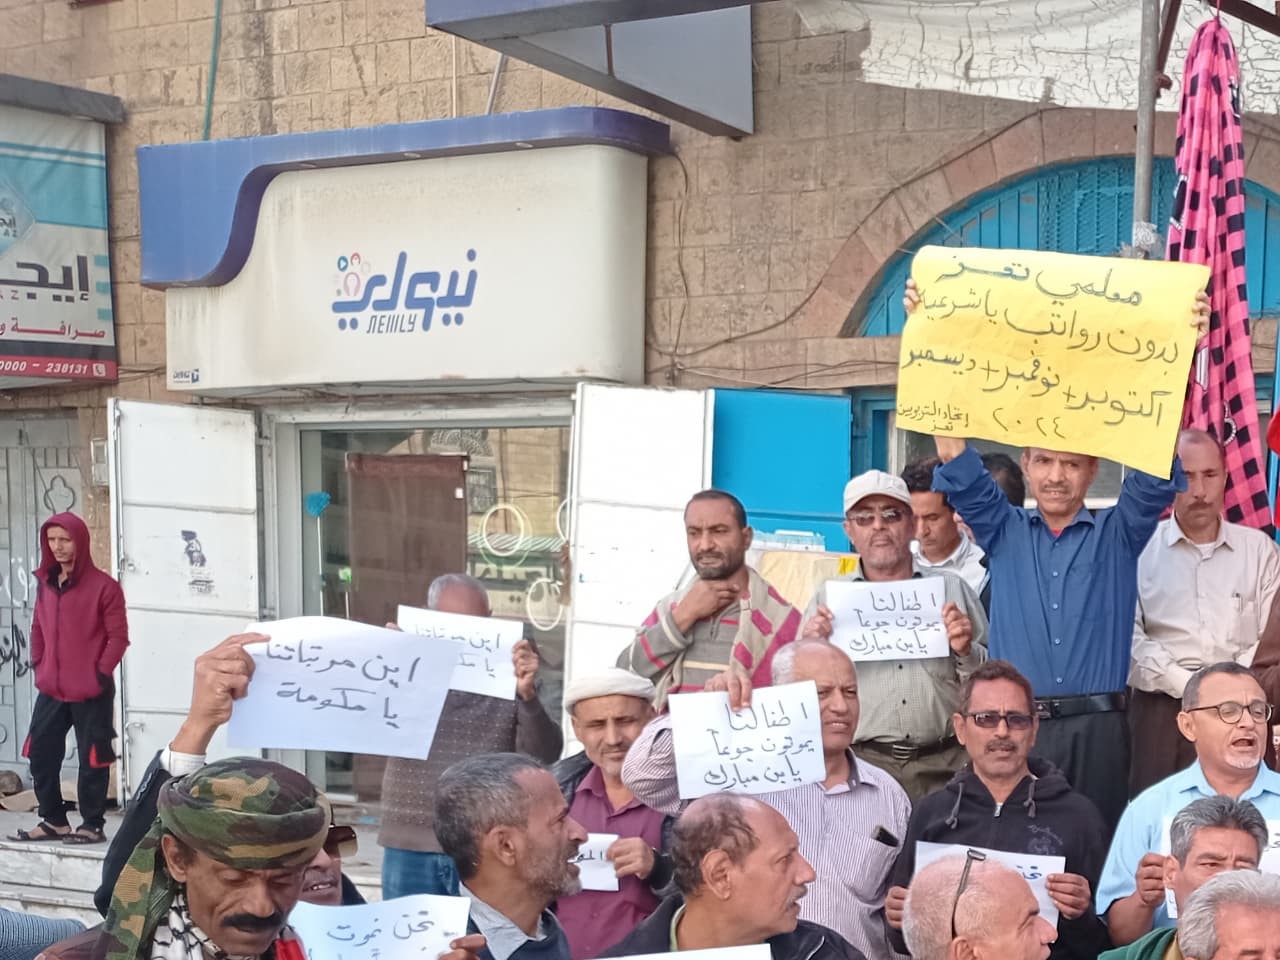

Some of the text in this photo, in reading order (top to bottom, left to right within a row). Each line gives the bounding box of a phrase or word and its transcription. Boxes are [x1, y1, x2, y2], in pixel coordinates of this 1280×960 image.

[0, 255, 90, 303] إيج
[332, 248, 478, 332] نيولي
[935, 256, 1030, 282] تعز
[1004, 307, 1101, 350] رواتب
[1108, 329, 1178, 376] بدون
